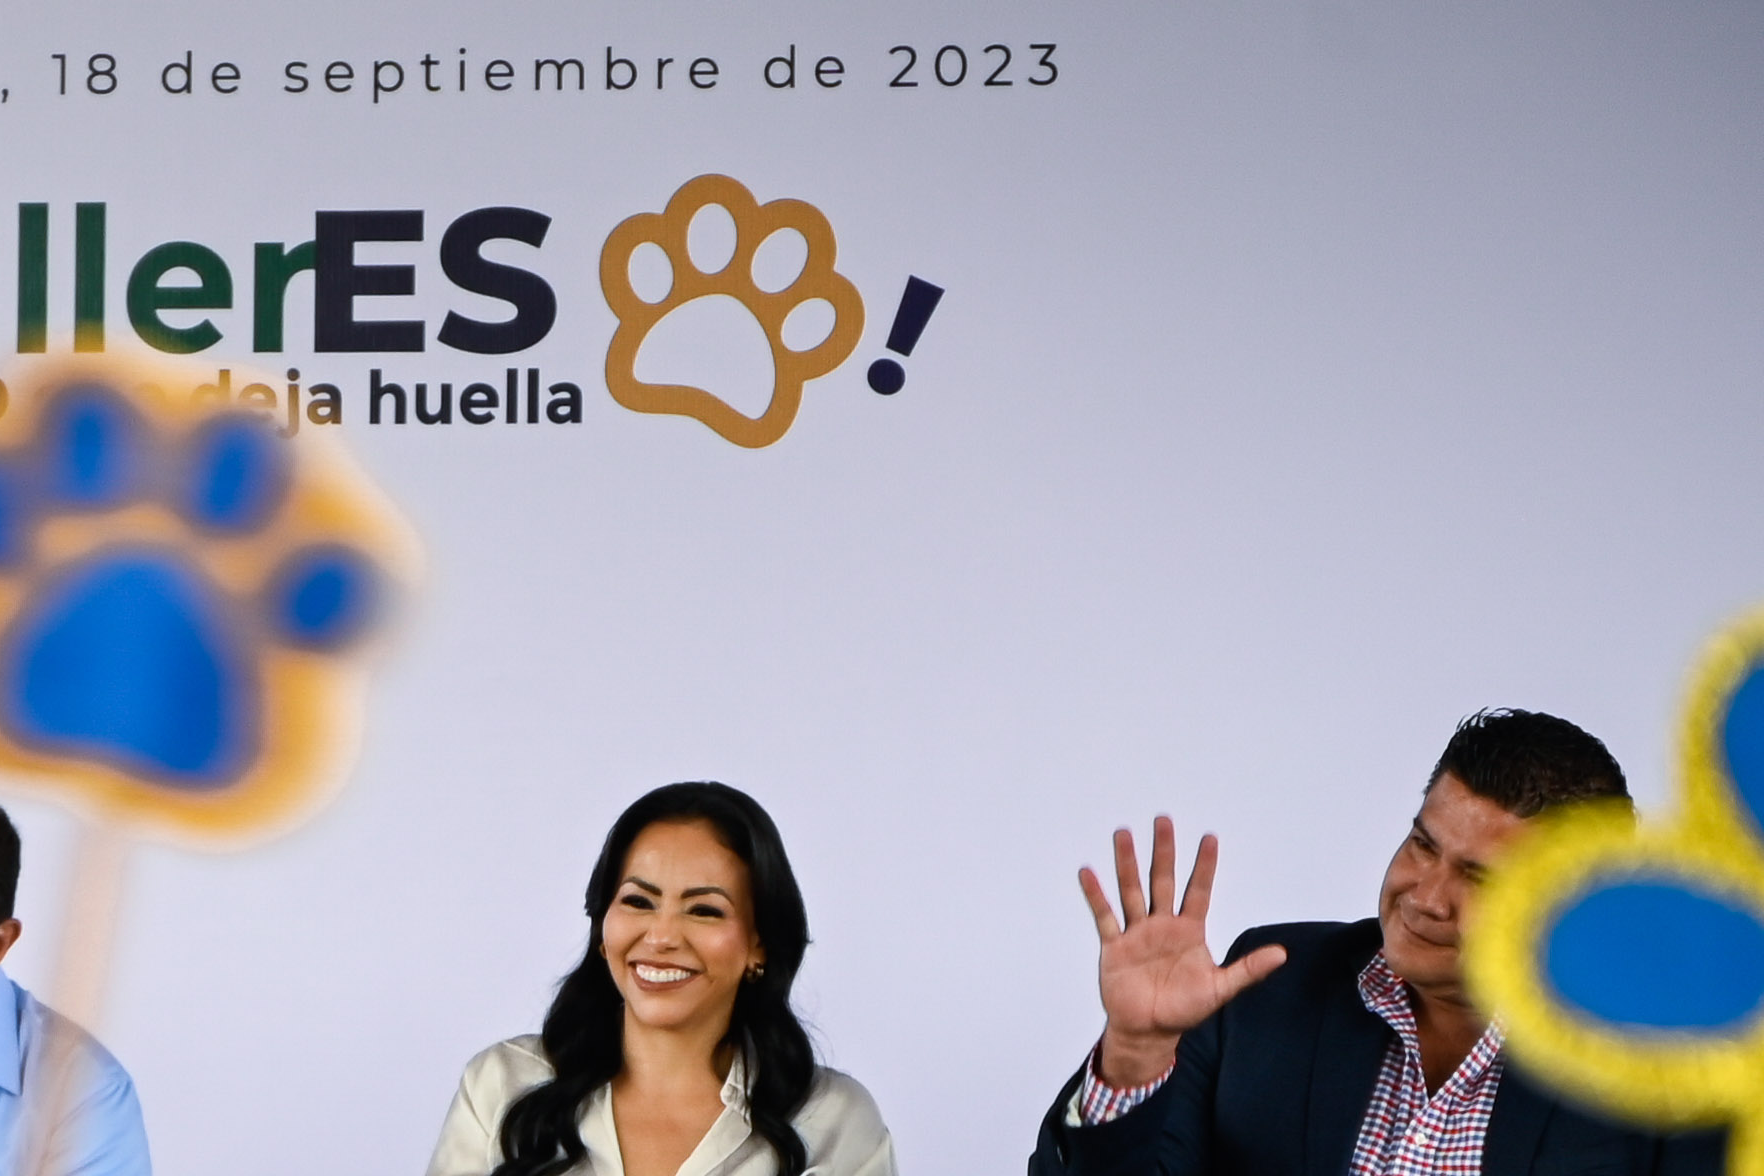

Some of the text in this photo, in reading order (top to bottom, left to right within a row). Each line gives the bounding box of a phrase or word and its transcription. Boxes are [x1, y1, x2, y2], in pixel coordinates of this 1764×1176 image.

[50, 53, 118, 96] 18
[160, 49, 242, 95] de
[283, 46, 720, 105] septiembre
[763, 43, 846, 89] de
[888, 43, 1059, 88] 2023
[368, 368, 583, 426] huella
